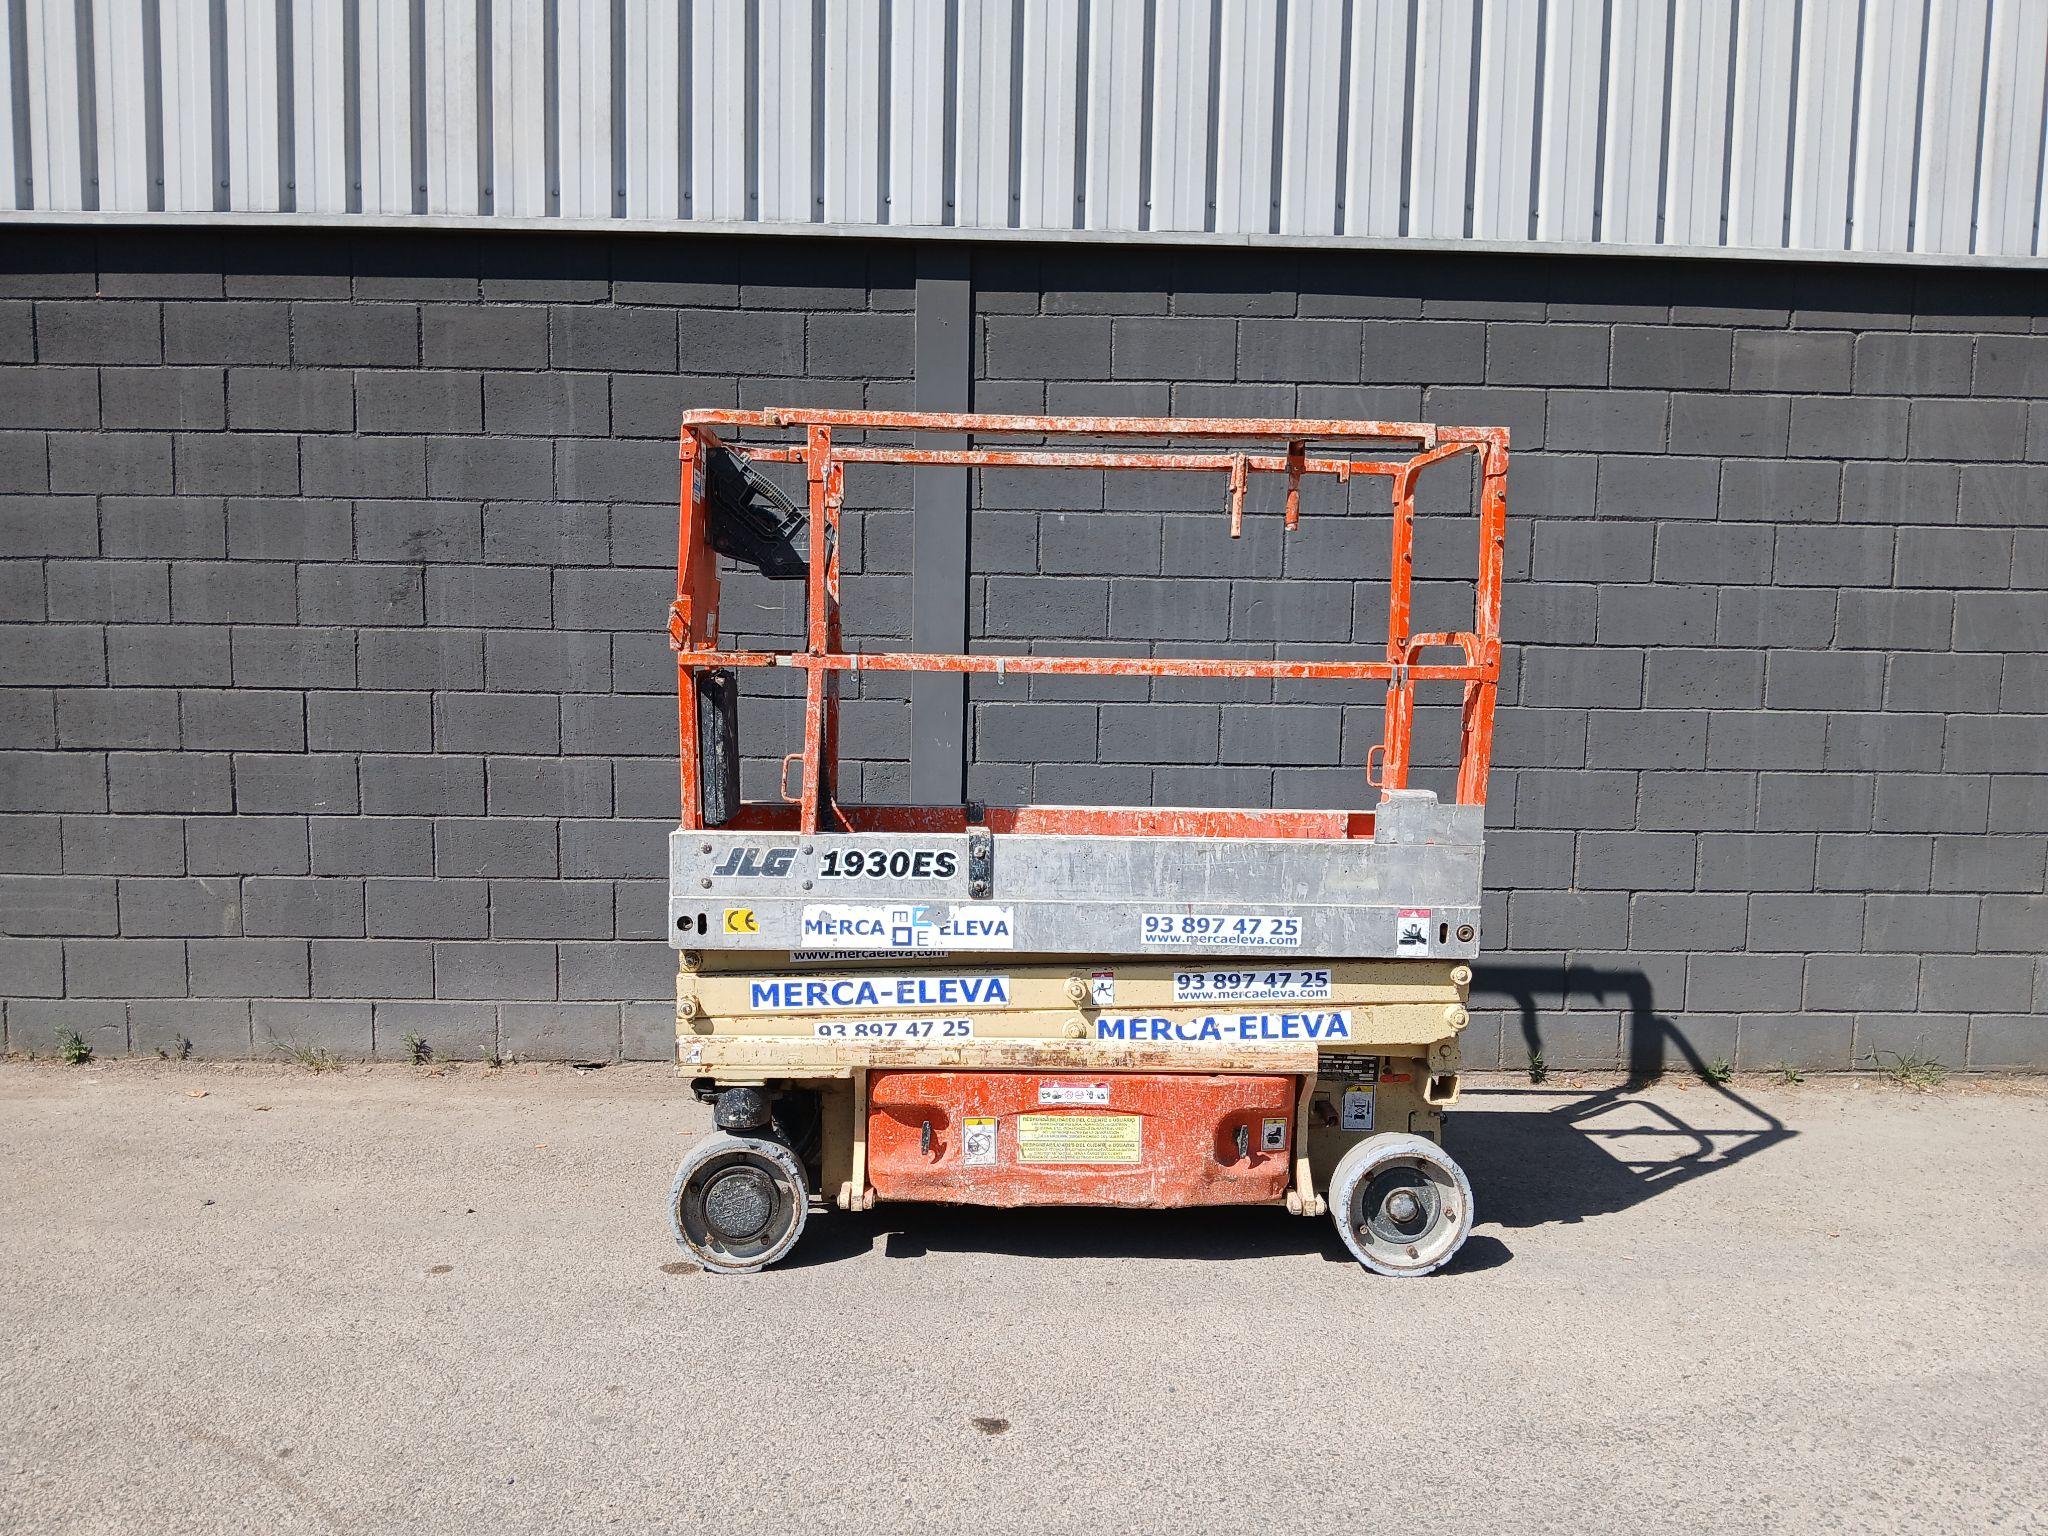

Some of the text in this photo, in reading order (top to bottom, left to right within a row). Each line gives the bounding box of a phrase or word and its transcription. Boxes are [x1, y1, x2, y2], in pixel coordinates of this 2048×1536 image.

[713, 847, 798, 877] JLG
[820, 850, 958, 878] 1930ES
[804, 919, 886, 936] MERCA
[1145, 916, 1298, 936] 93 897 47 25
[1177, 971, 1329, 991] 93 897 47 25
[751, 978, 1008, 1008] MERCA-ELEVA
[1177, 988, 1329, 1000] www.mercaeleva.com
[854, 1023, 898, 1037] 897
[905, 1022, 934, 1037] 47
[942, 1020, 971, 1037] 25
[1097, 1013, 1349, 1041] MERCA-ELEVA
